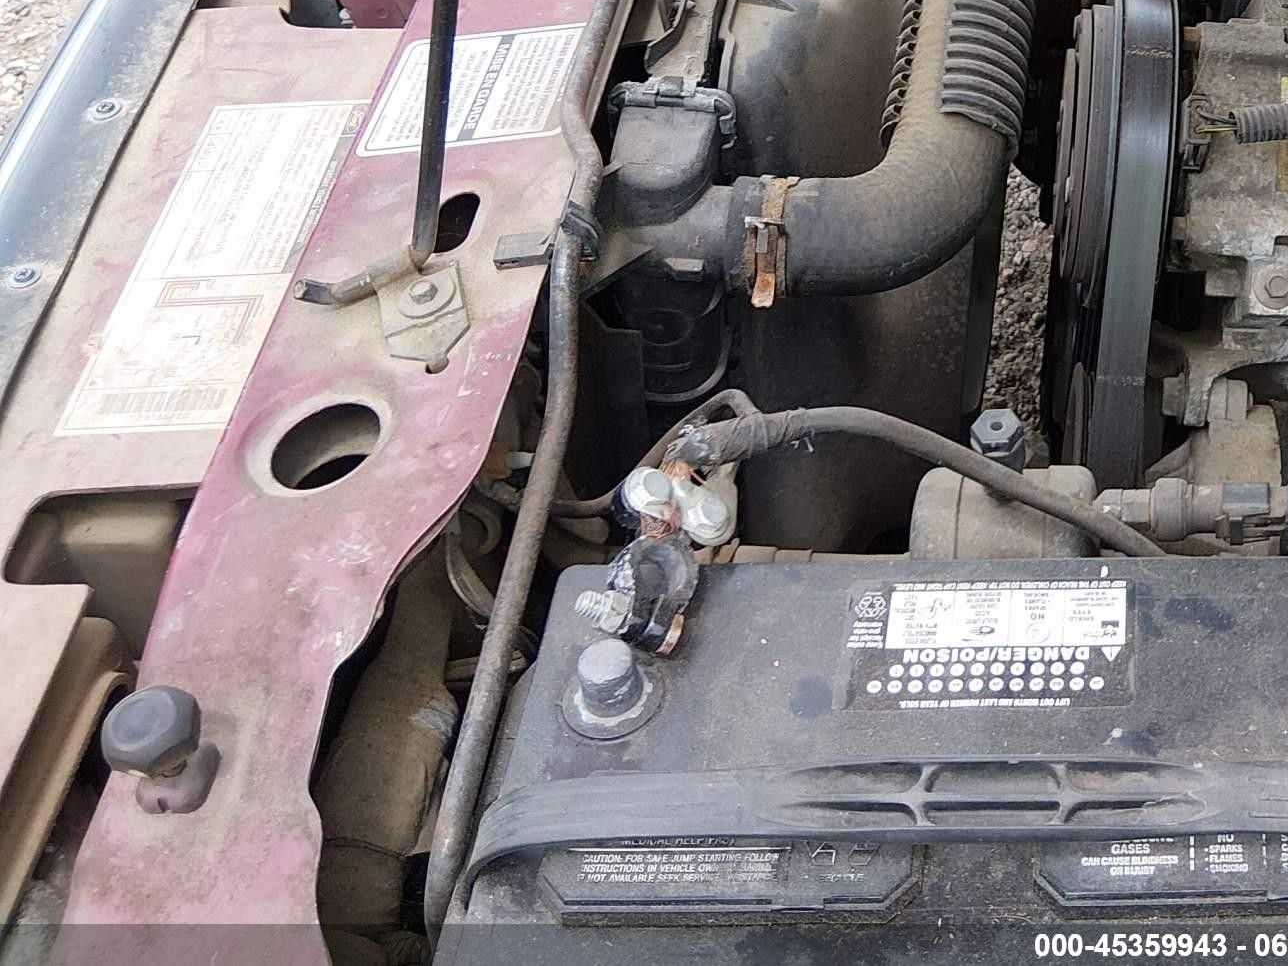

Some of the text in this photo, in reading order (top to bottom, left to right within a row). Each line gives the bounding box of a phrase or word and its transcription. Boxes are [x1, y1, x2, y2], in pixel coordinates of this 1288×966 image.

[488, 43, 510, 70] MISE
[480, 71, 498, 87] EN
[462, 88, 490, 130] GARDE
[902, 646, 1090, 661] DANGER/POISON
[1053, 698, 1070, 706] LIFT
[1111, 844, 1150, 854] GASES
[1209, 844, 1243, 853] SPARKS
[647, 854, 668, 862] SAFE
[672, 854, 695, 862] JUMP
[699, 854, 742, 862] STARTING
[1081, 856, 1179, 866] CAN CAUSE BLINDNESS
[1209, 854, 1244, 863] FLAMES
[581, 864, 644, 872] INSTRUCTIONS
[648, 864, 657, 872] IN
[660, 864, 695, 872] VEHICLE
[1110, 866, 1155, 875] OR INJURY
[1210, 864, 1249, 872] SMOKING
[587, 874, 607, 882] NOT
[610, 874, 655, 883] AVAILABLE
[658, 874, 680, 882] SEEK
